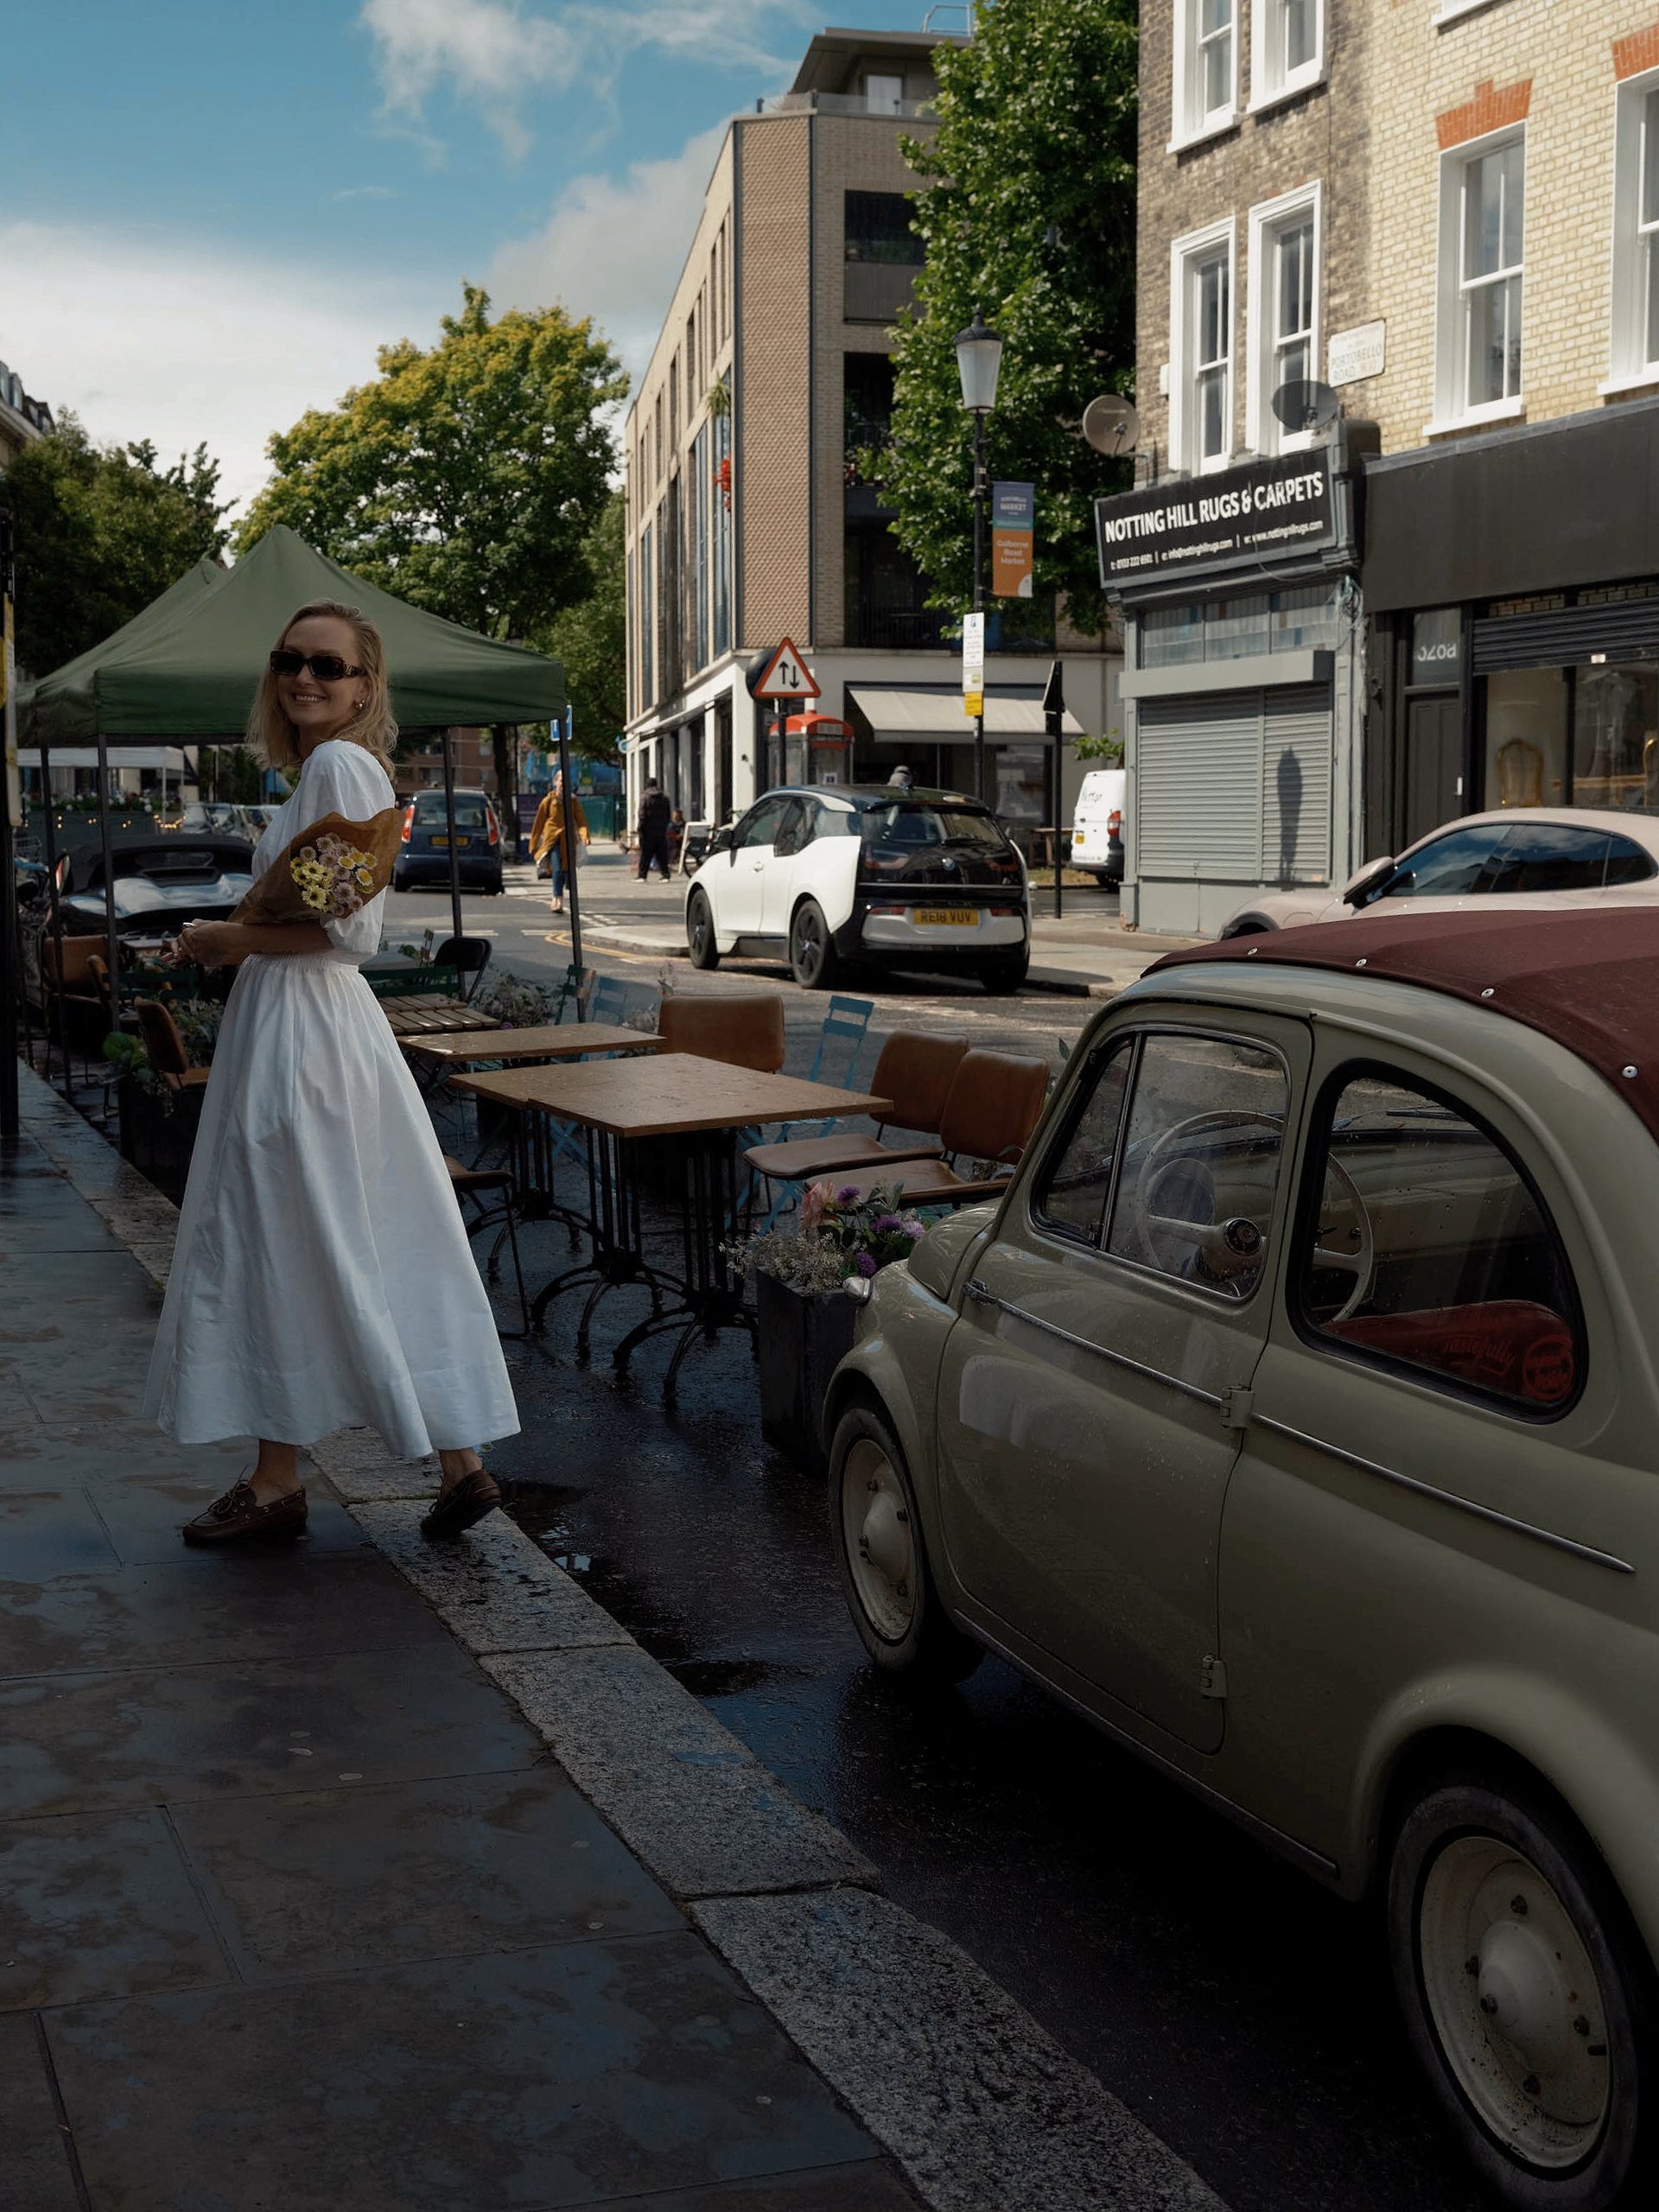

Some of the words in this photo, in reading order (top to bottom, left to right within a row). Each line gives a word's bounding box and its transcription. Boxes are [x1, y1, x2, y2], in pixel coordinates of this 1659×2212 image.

[1104, 509, 1166, 543] NOTTING
[1166, 503, 1199, 530] HILL
[1198, 492, 1240, 523] RUGS
[1241, 489, 1252, 513] &
[1254, 471, 1324, 511] CARPETS
[920, 911, 947, 923] RE18
[949, 911, 971, 923] VUV
